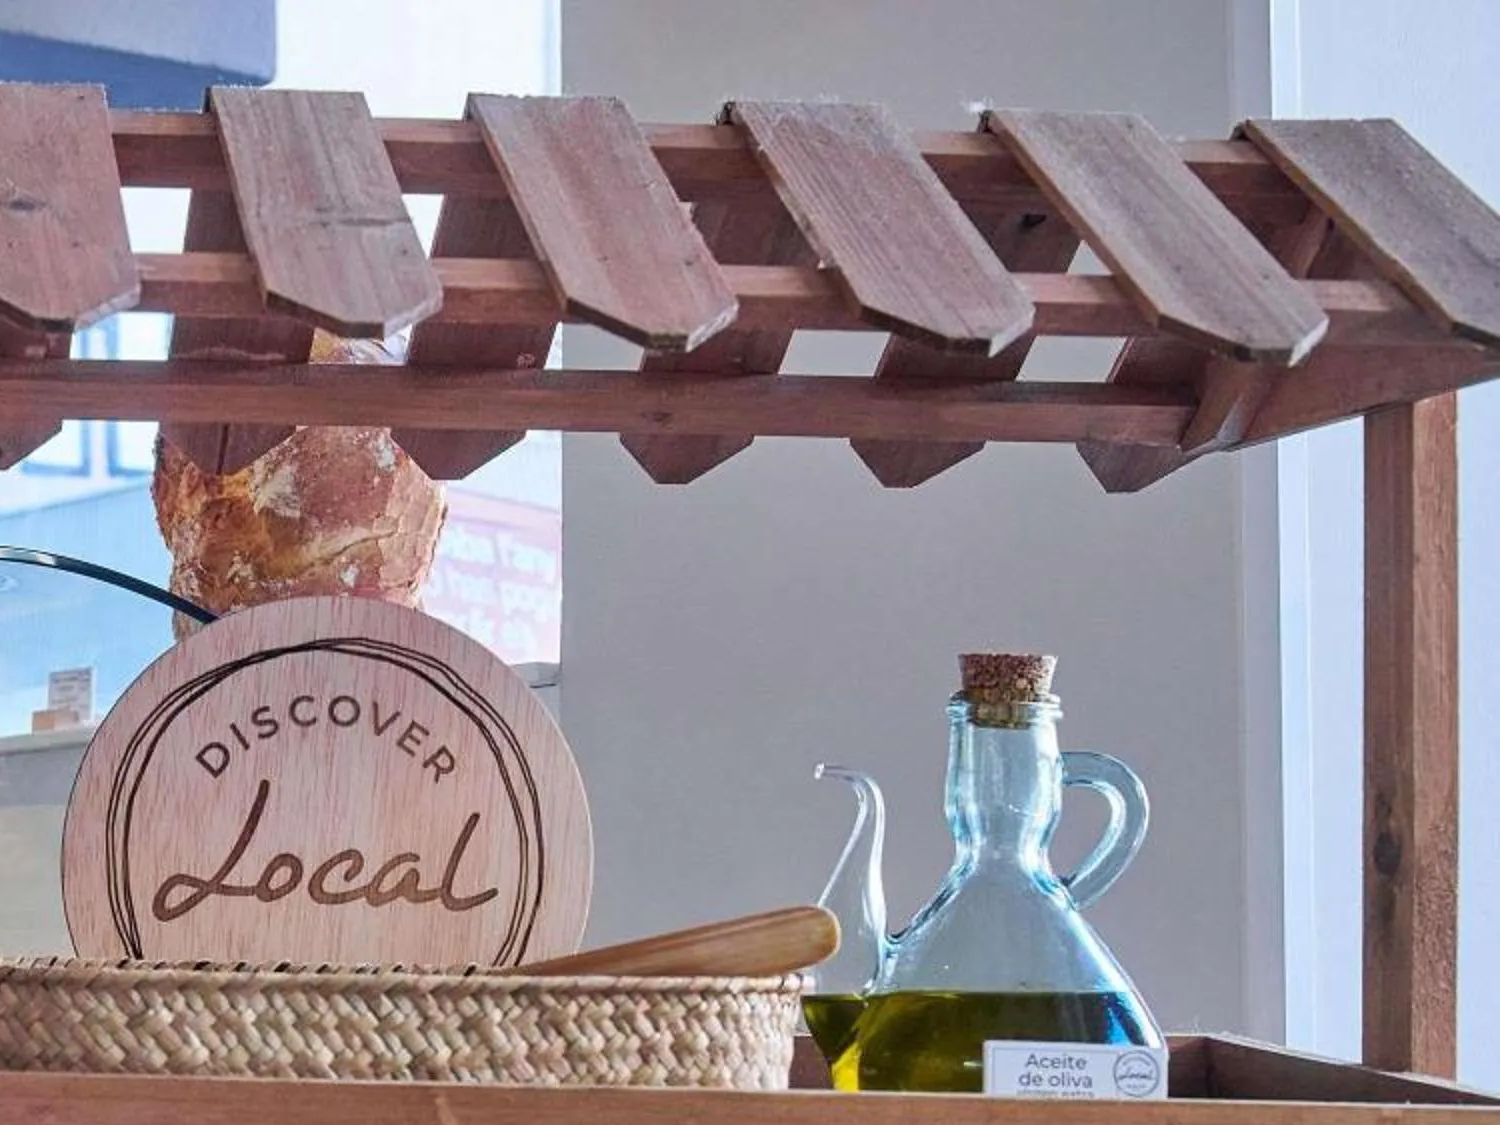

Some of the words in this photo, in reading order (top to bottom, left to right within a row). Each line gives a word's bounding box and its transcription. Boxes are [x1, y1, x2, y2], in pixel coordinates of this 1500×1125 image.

[195, 694, 455, 783] DISCOVER
[152, 779, 499, 923] Local
[1018, 1073, 1043, 1087] de
[1048, 1072, 1093, 1088] oliva
[1025, 1054, 1087, 1070] Aceite
